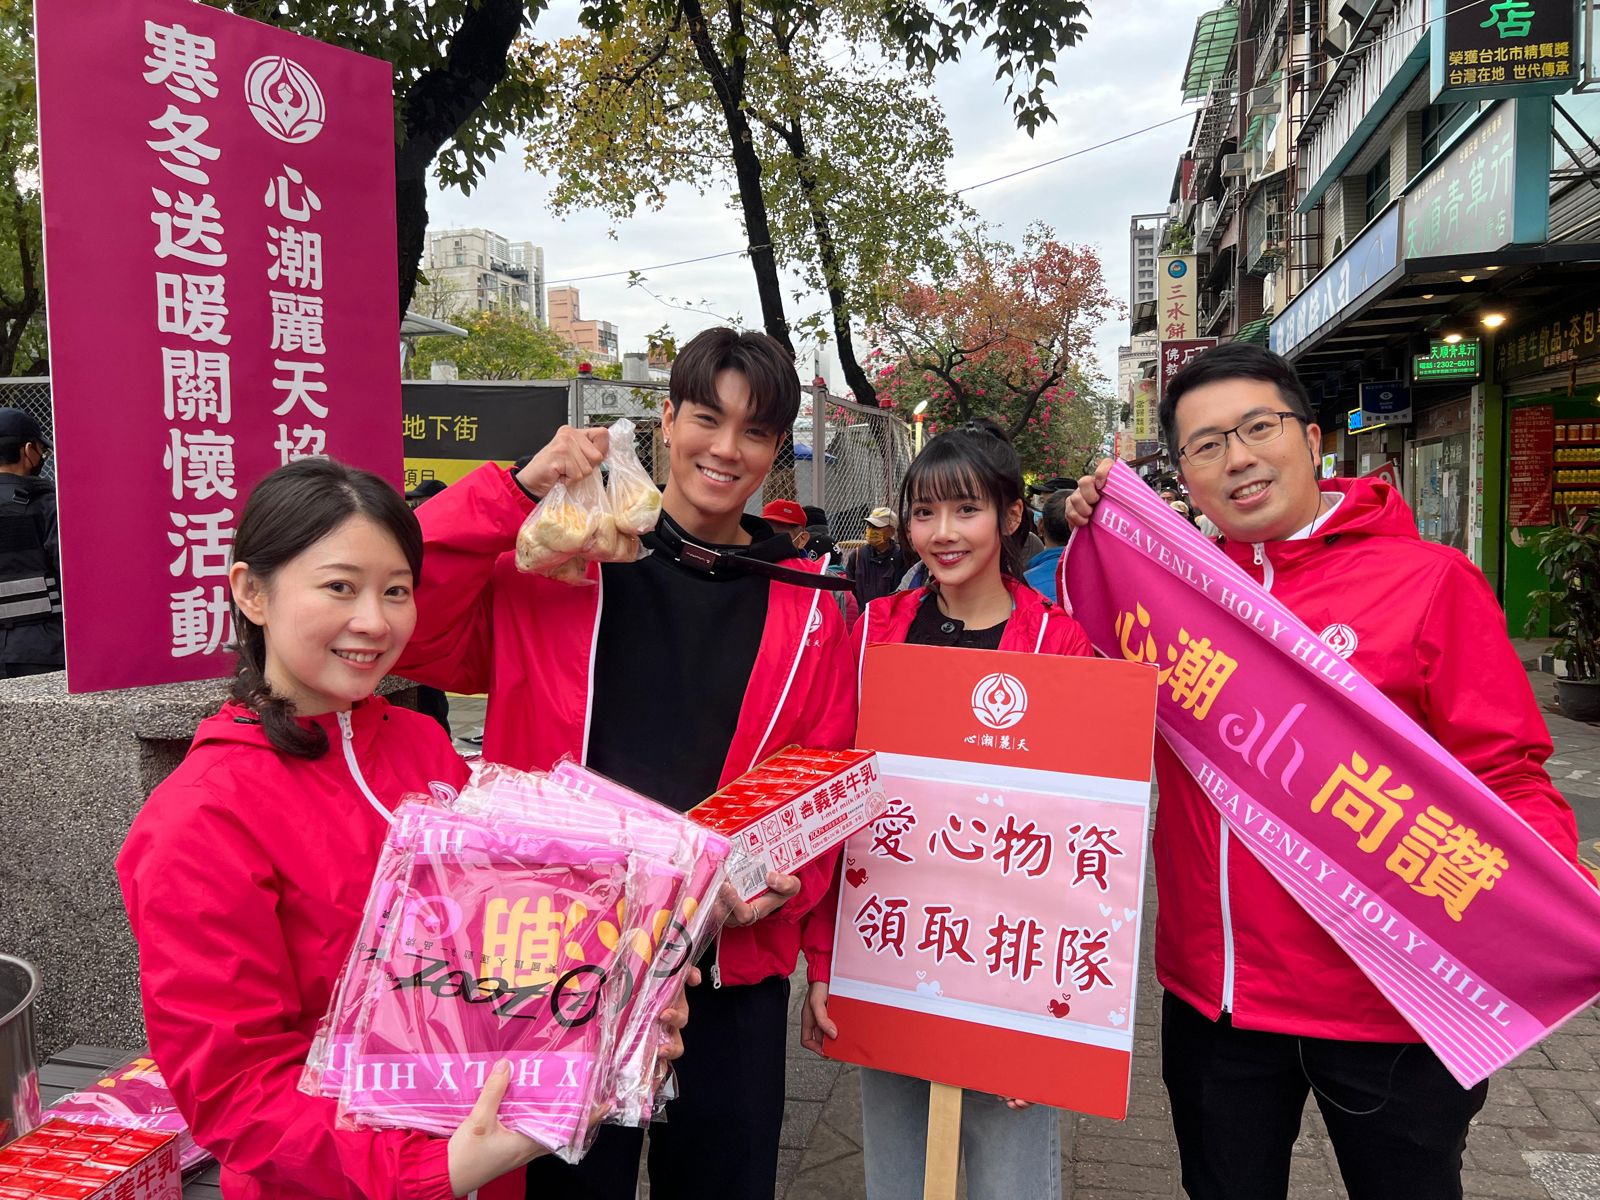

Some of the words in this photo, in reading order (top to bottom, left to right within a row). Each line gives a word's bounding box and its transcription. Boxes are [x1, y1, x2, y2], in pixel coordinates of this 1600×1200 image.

[1450, 66, 1505, 85] 台灣在地
[1513, 60, 1569, 80] 世代傳承
[142, 20, 238, 659] 寒冬送暖關懷活動
[402, 414, 478, 442] 地下街
[1101, 507, 1214, 594] HEAVENLY
[1219, 584, 1290, 641] HOLY
[1293, 635, 1359, 693] HILL
[812, 762, 877, 814] 義美牛乳
[1309, 749, 1511, 922] 尚讚
[868, 799, 1124, 890] 愛心物資
[852, 894, 1114, 992] 領取排隊
[1196, 761, 1337, 892] HEAVENLY
[1338, 882, 1429, 951] HOLY
[1429, 944, 1514, 1029] HILL
